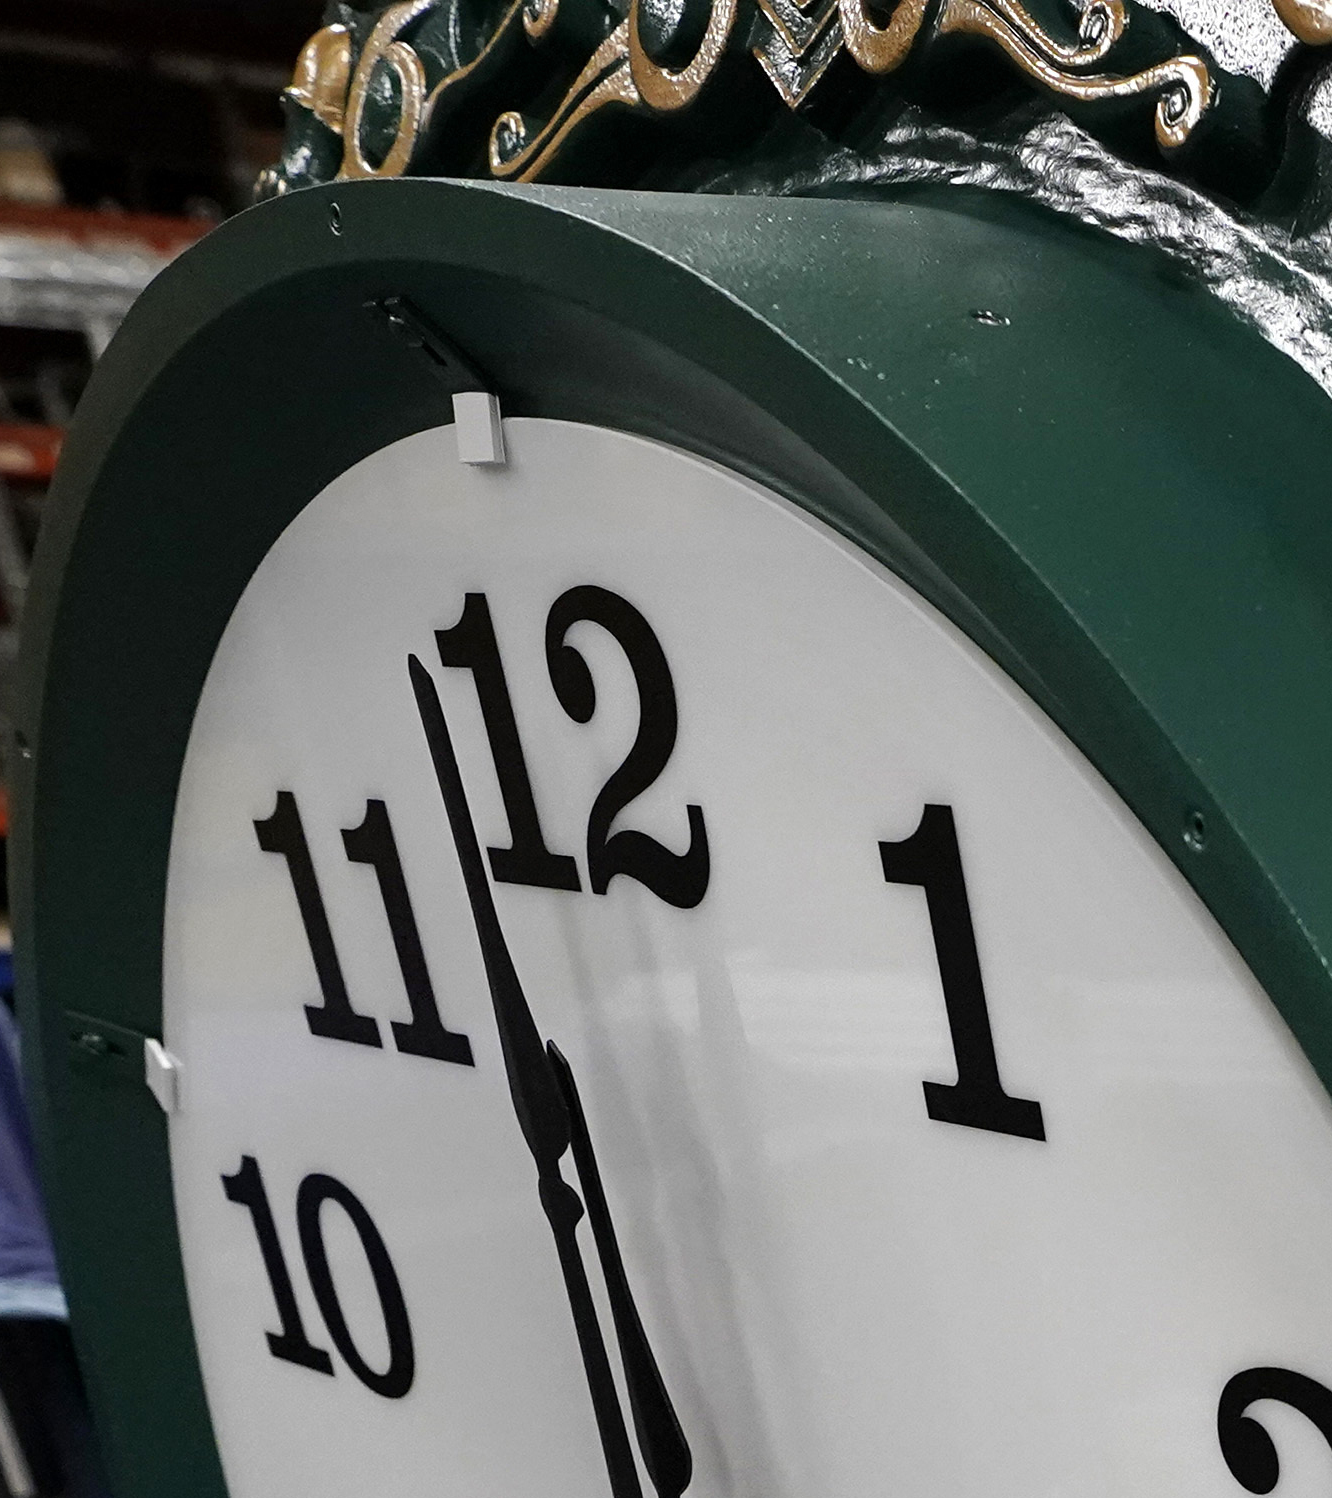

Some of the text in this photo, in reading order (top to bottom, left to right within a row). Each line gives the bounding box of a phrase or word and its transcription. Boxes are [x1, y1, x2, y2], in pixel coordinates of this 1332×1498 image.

[434, 585, 710, 909] 12
[253, 790, 475, 1067] 11
[878, 804, 1046, 1142] 1
[221, 1155, 415, 1399] 10
